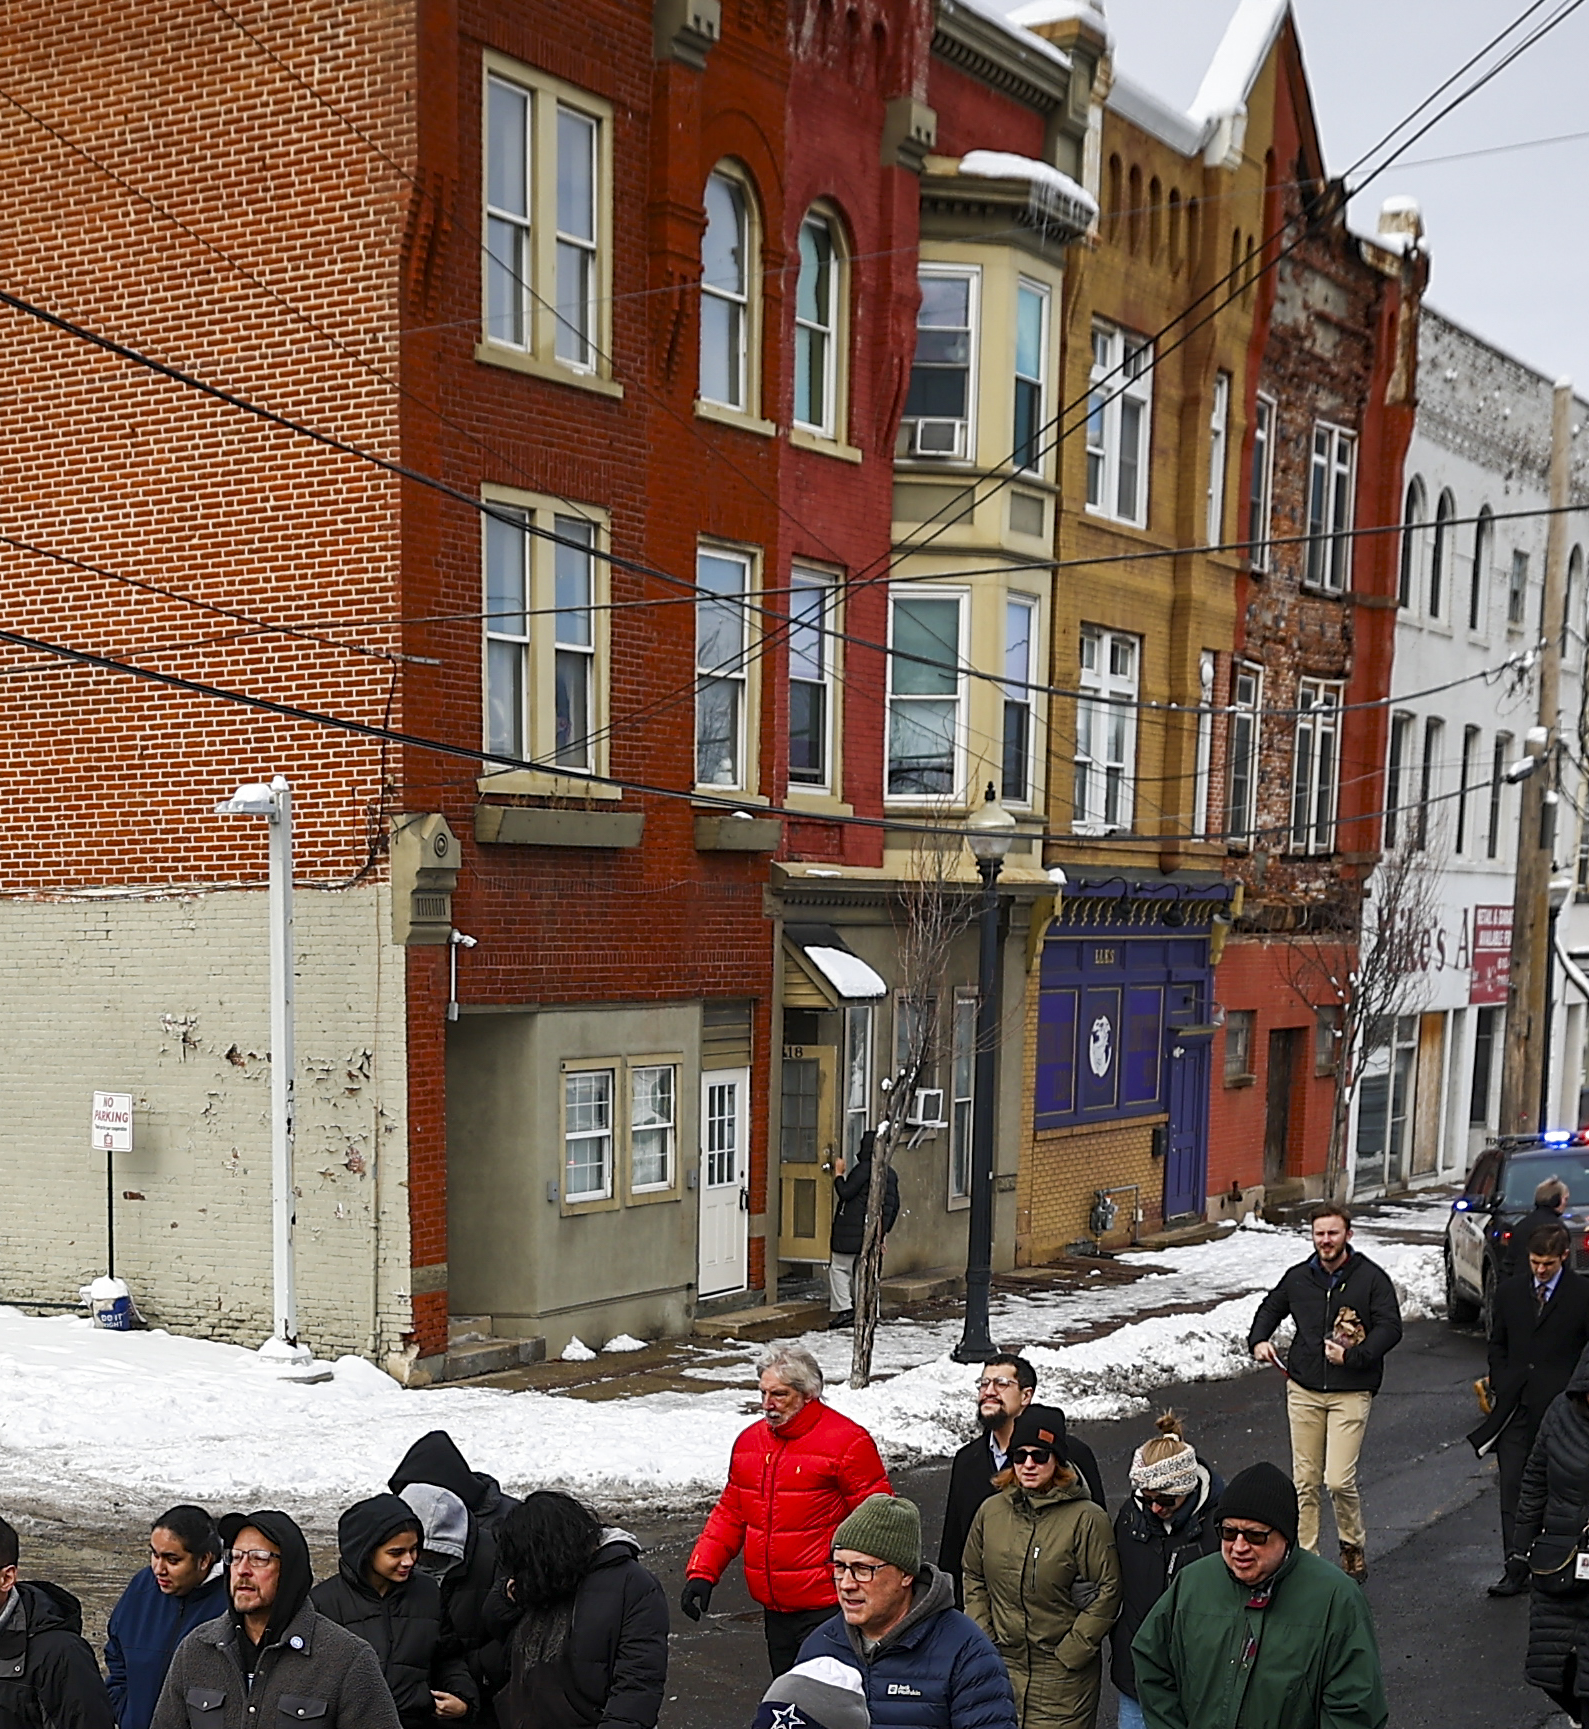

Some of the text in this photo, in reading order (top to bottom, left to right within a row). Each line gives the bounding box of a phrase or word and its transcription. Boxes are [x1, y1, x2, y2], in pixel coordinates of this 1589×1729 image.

[103, 1096, 114, 1108] NO
[94, 1109, 129, 1123] PARKING
[100, 1314, 113, 1322] DO
